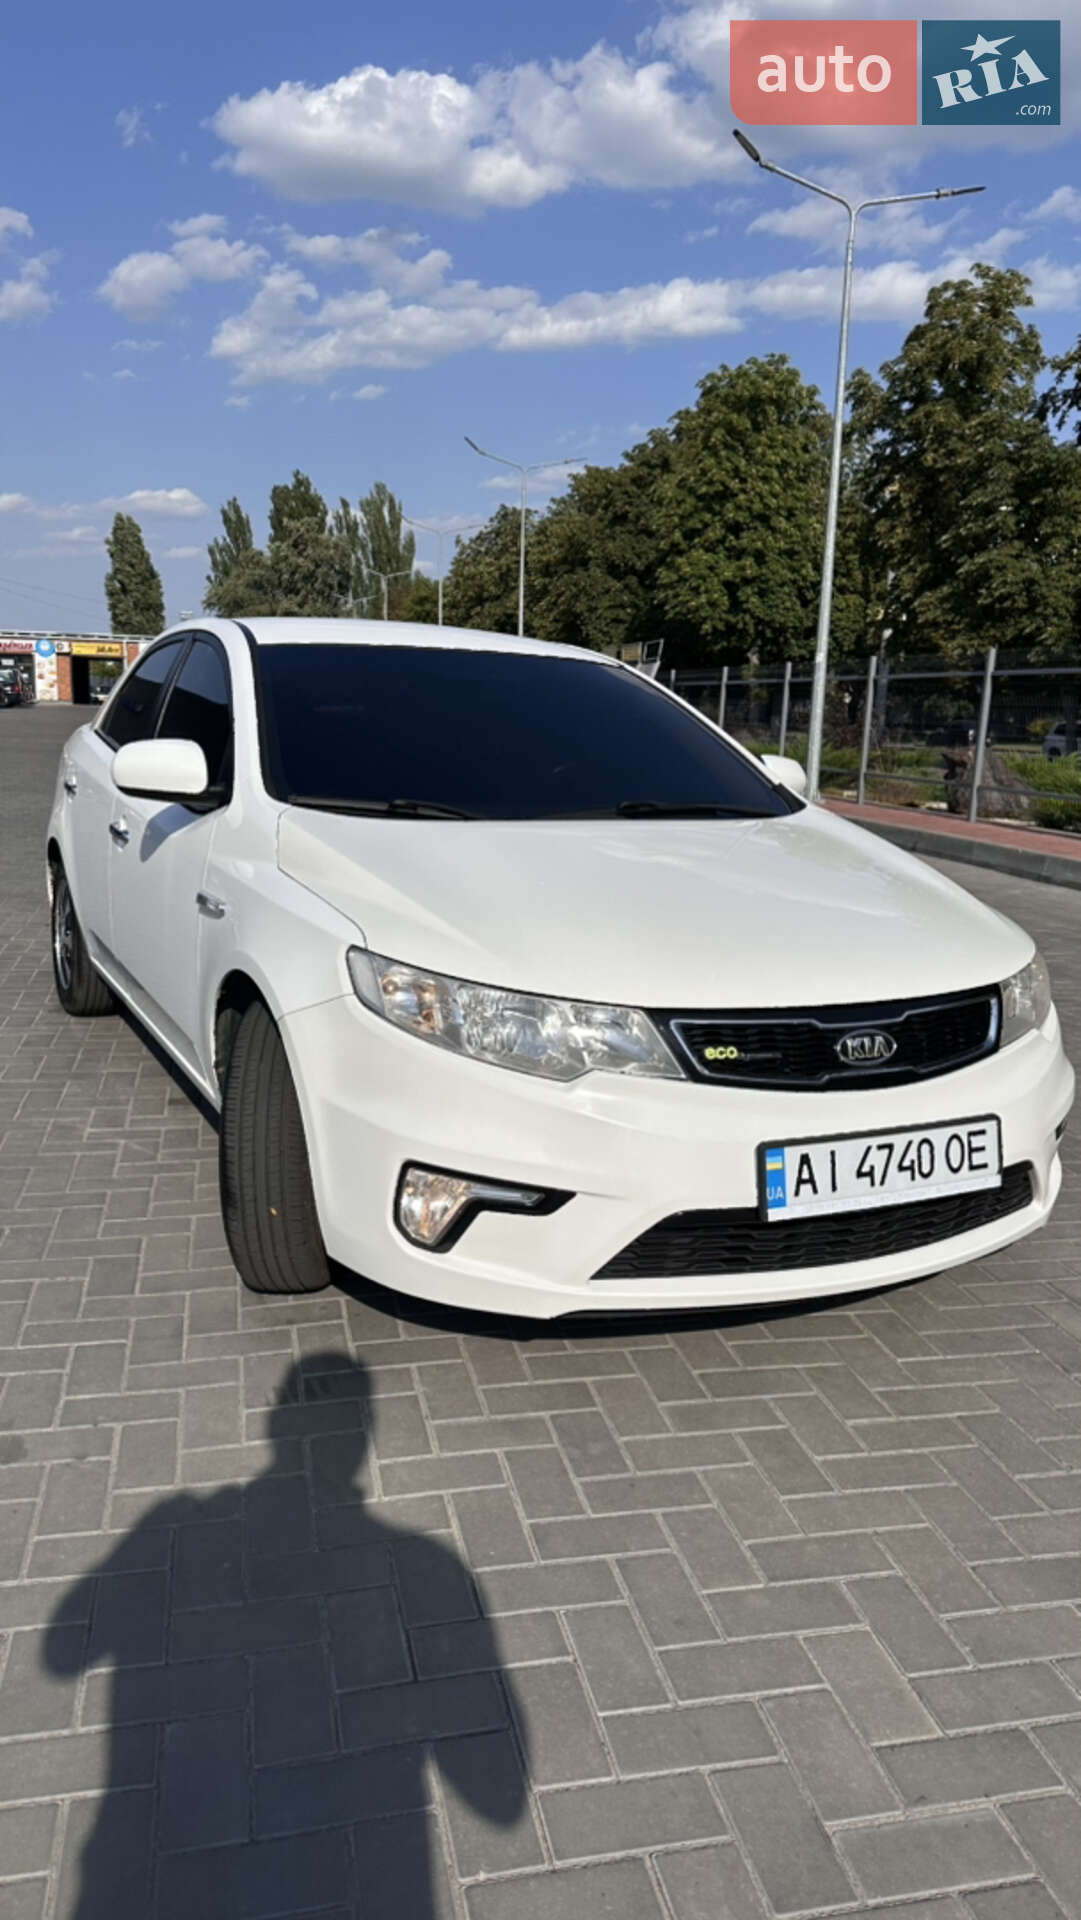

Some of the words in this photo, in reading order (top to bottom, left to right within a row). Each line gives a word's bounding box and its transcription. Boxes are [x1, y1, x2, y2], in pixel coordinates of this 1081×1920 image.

[704, 1045, 738, 1060] eco
[845, 1035, 890, 1061] KIA
[856, 1137, 935, 1188] 4740
[945, 1129, 989, 1175] OE
[766, 1187, 785, 1200] UA
